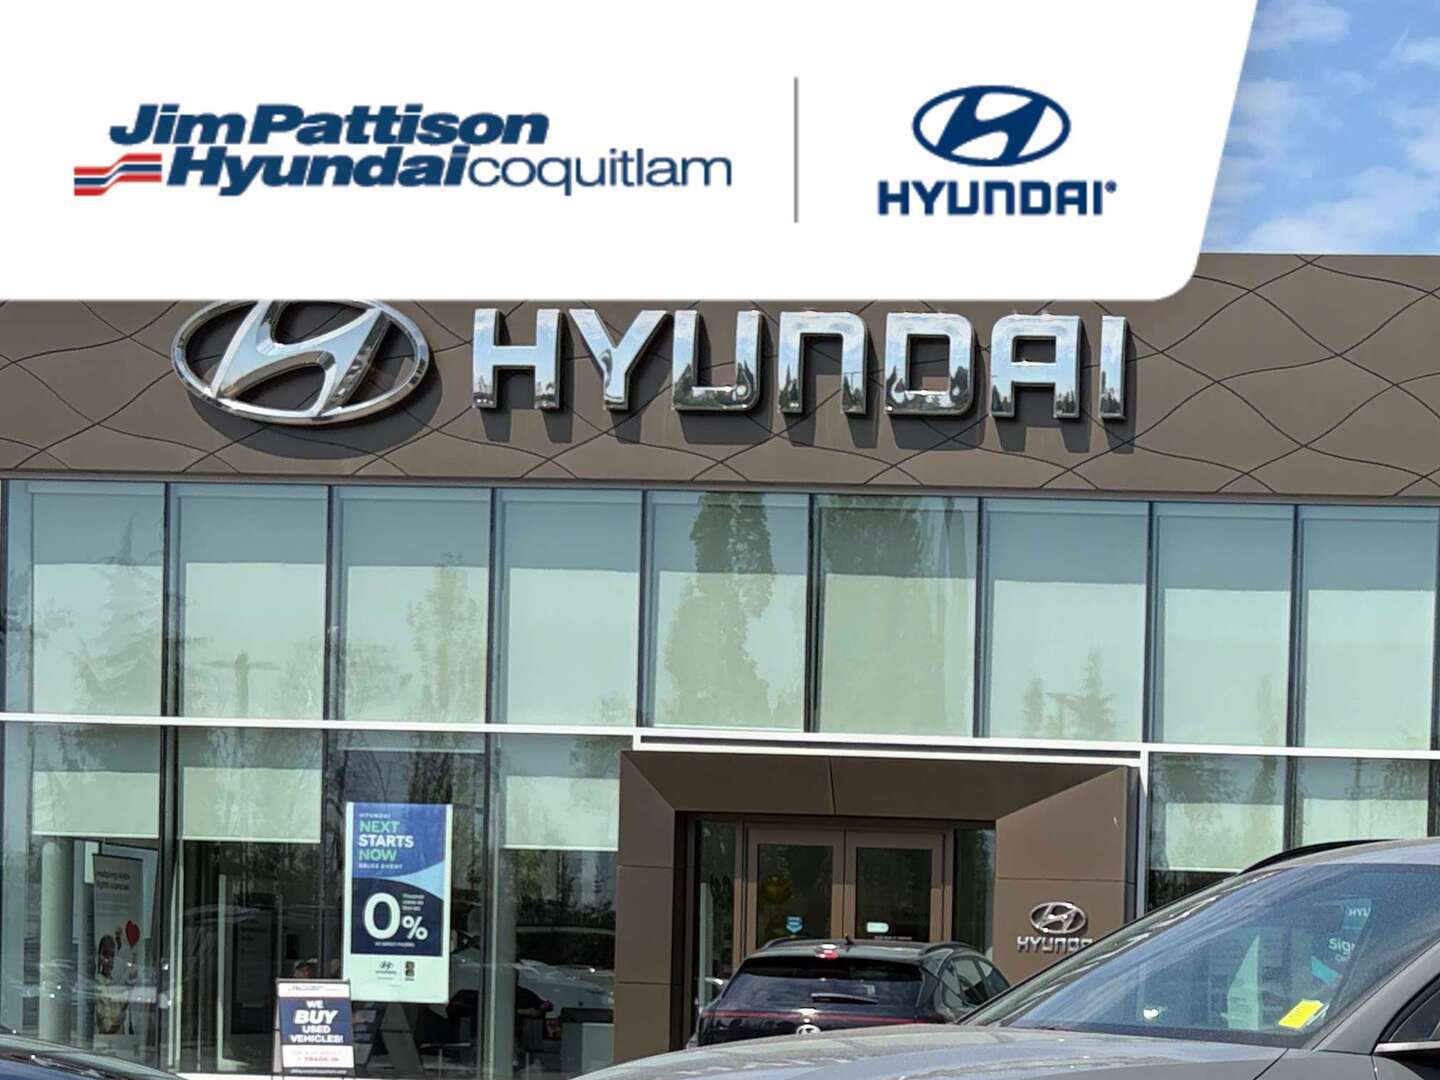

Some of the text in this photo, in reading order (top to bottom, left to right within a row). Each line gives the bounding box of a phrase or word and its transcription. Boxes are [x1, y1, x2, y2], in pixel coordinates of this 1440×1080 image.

[472, 308, 1128, 421] HYUNDAI
[359, 820, 400, 833] NEXT
[358, 834, 415, 849] STARTS
[358, 848, 398, 861] NOW
[306, 1000, 323, 1009] WE
[294, 1010, 338, 1024] BUY
[302, 1025, 331, 1034] USED
[289, 1034, 344, 1044] VEHICLES!
